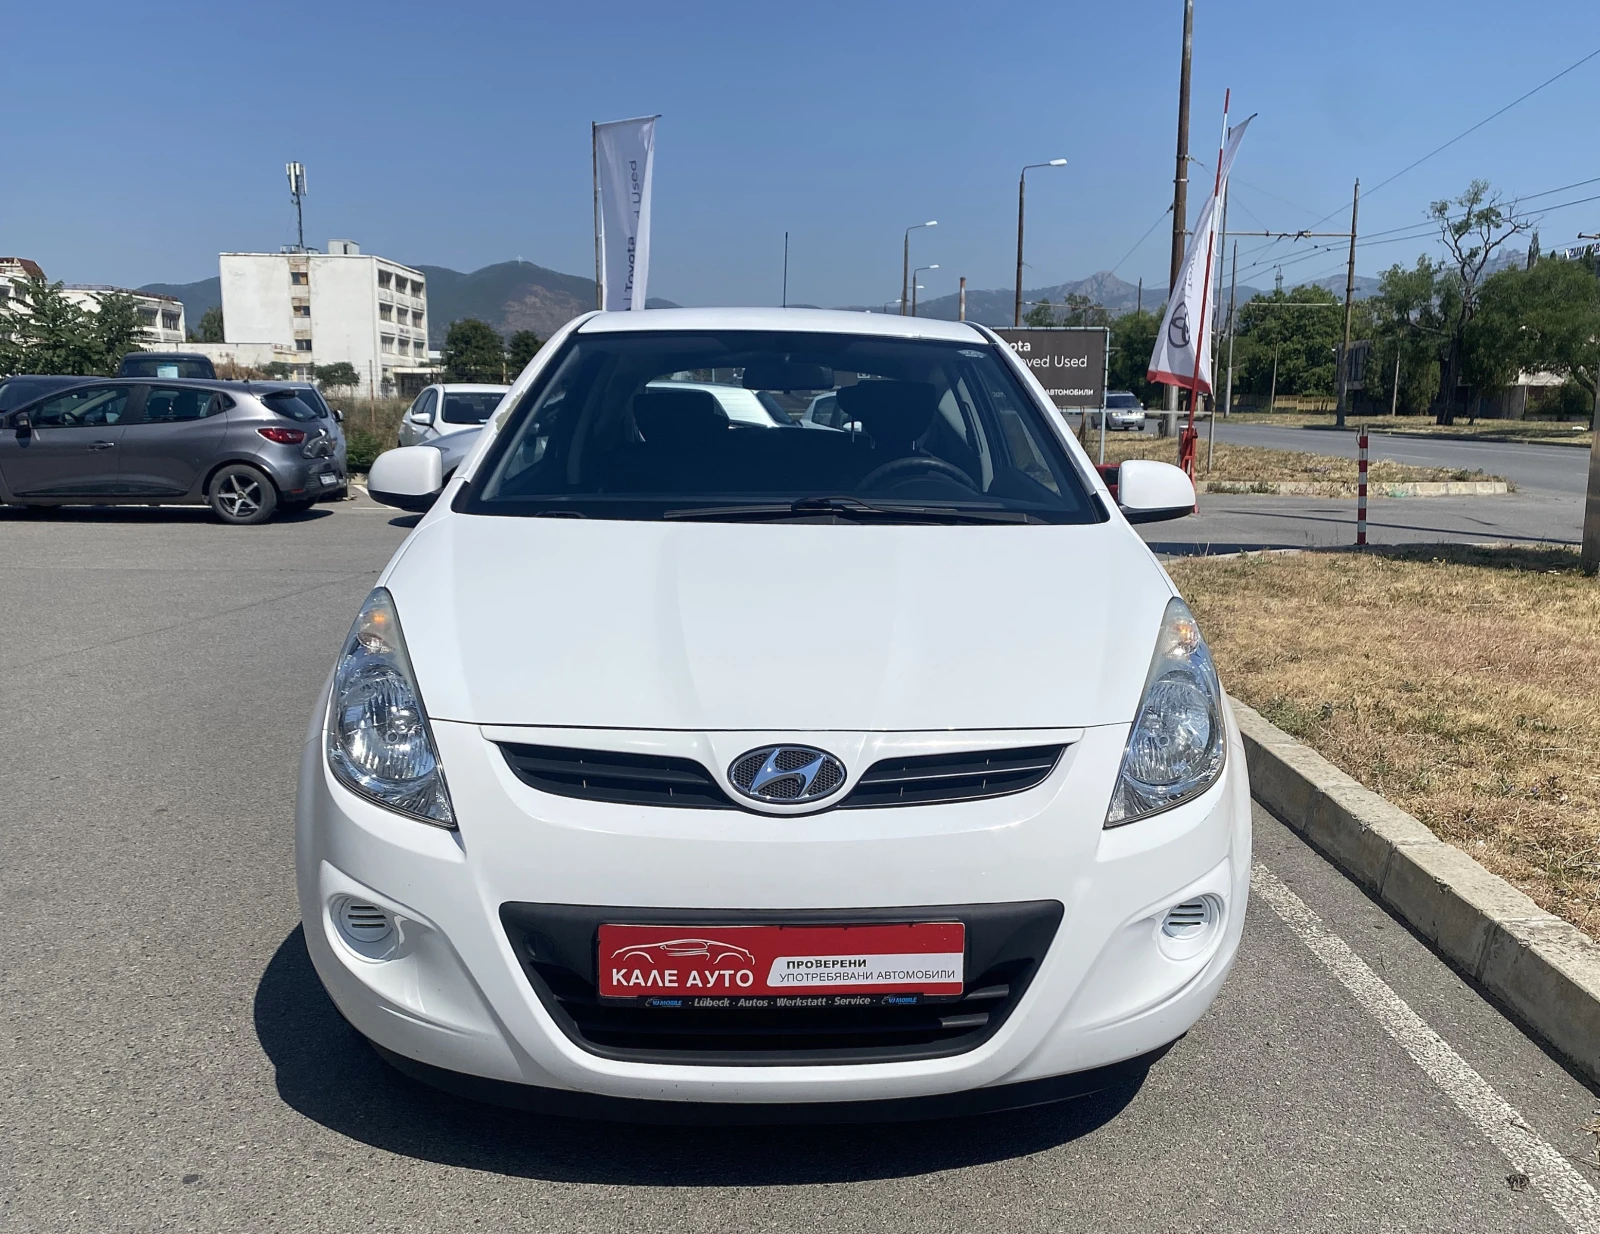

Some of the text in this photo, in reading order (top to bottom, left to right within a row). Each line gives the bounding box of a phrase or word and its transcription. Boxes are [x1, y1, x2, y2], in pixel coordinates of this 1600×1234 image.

[629, 160, 641, 204] Used
[1007, 340, 1031, 351] ota
[1054, 354, 1088, 368] Used
[786, 958, 867, 970] ПРОВЕРЕНИ
[612, 968, 754, 988] КАЛЕ АУТО
[779, 969, 955, 983] УПОТРЕБЯВАНИ АВТОМОБИЛИ
[694, 997, 730, 1007] Lübeck
[737, 998, 769, 1007] Autos
[776, 997, 826, 1007] Werkstatt
[834, 996, 871, 1006] Service
